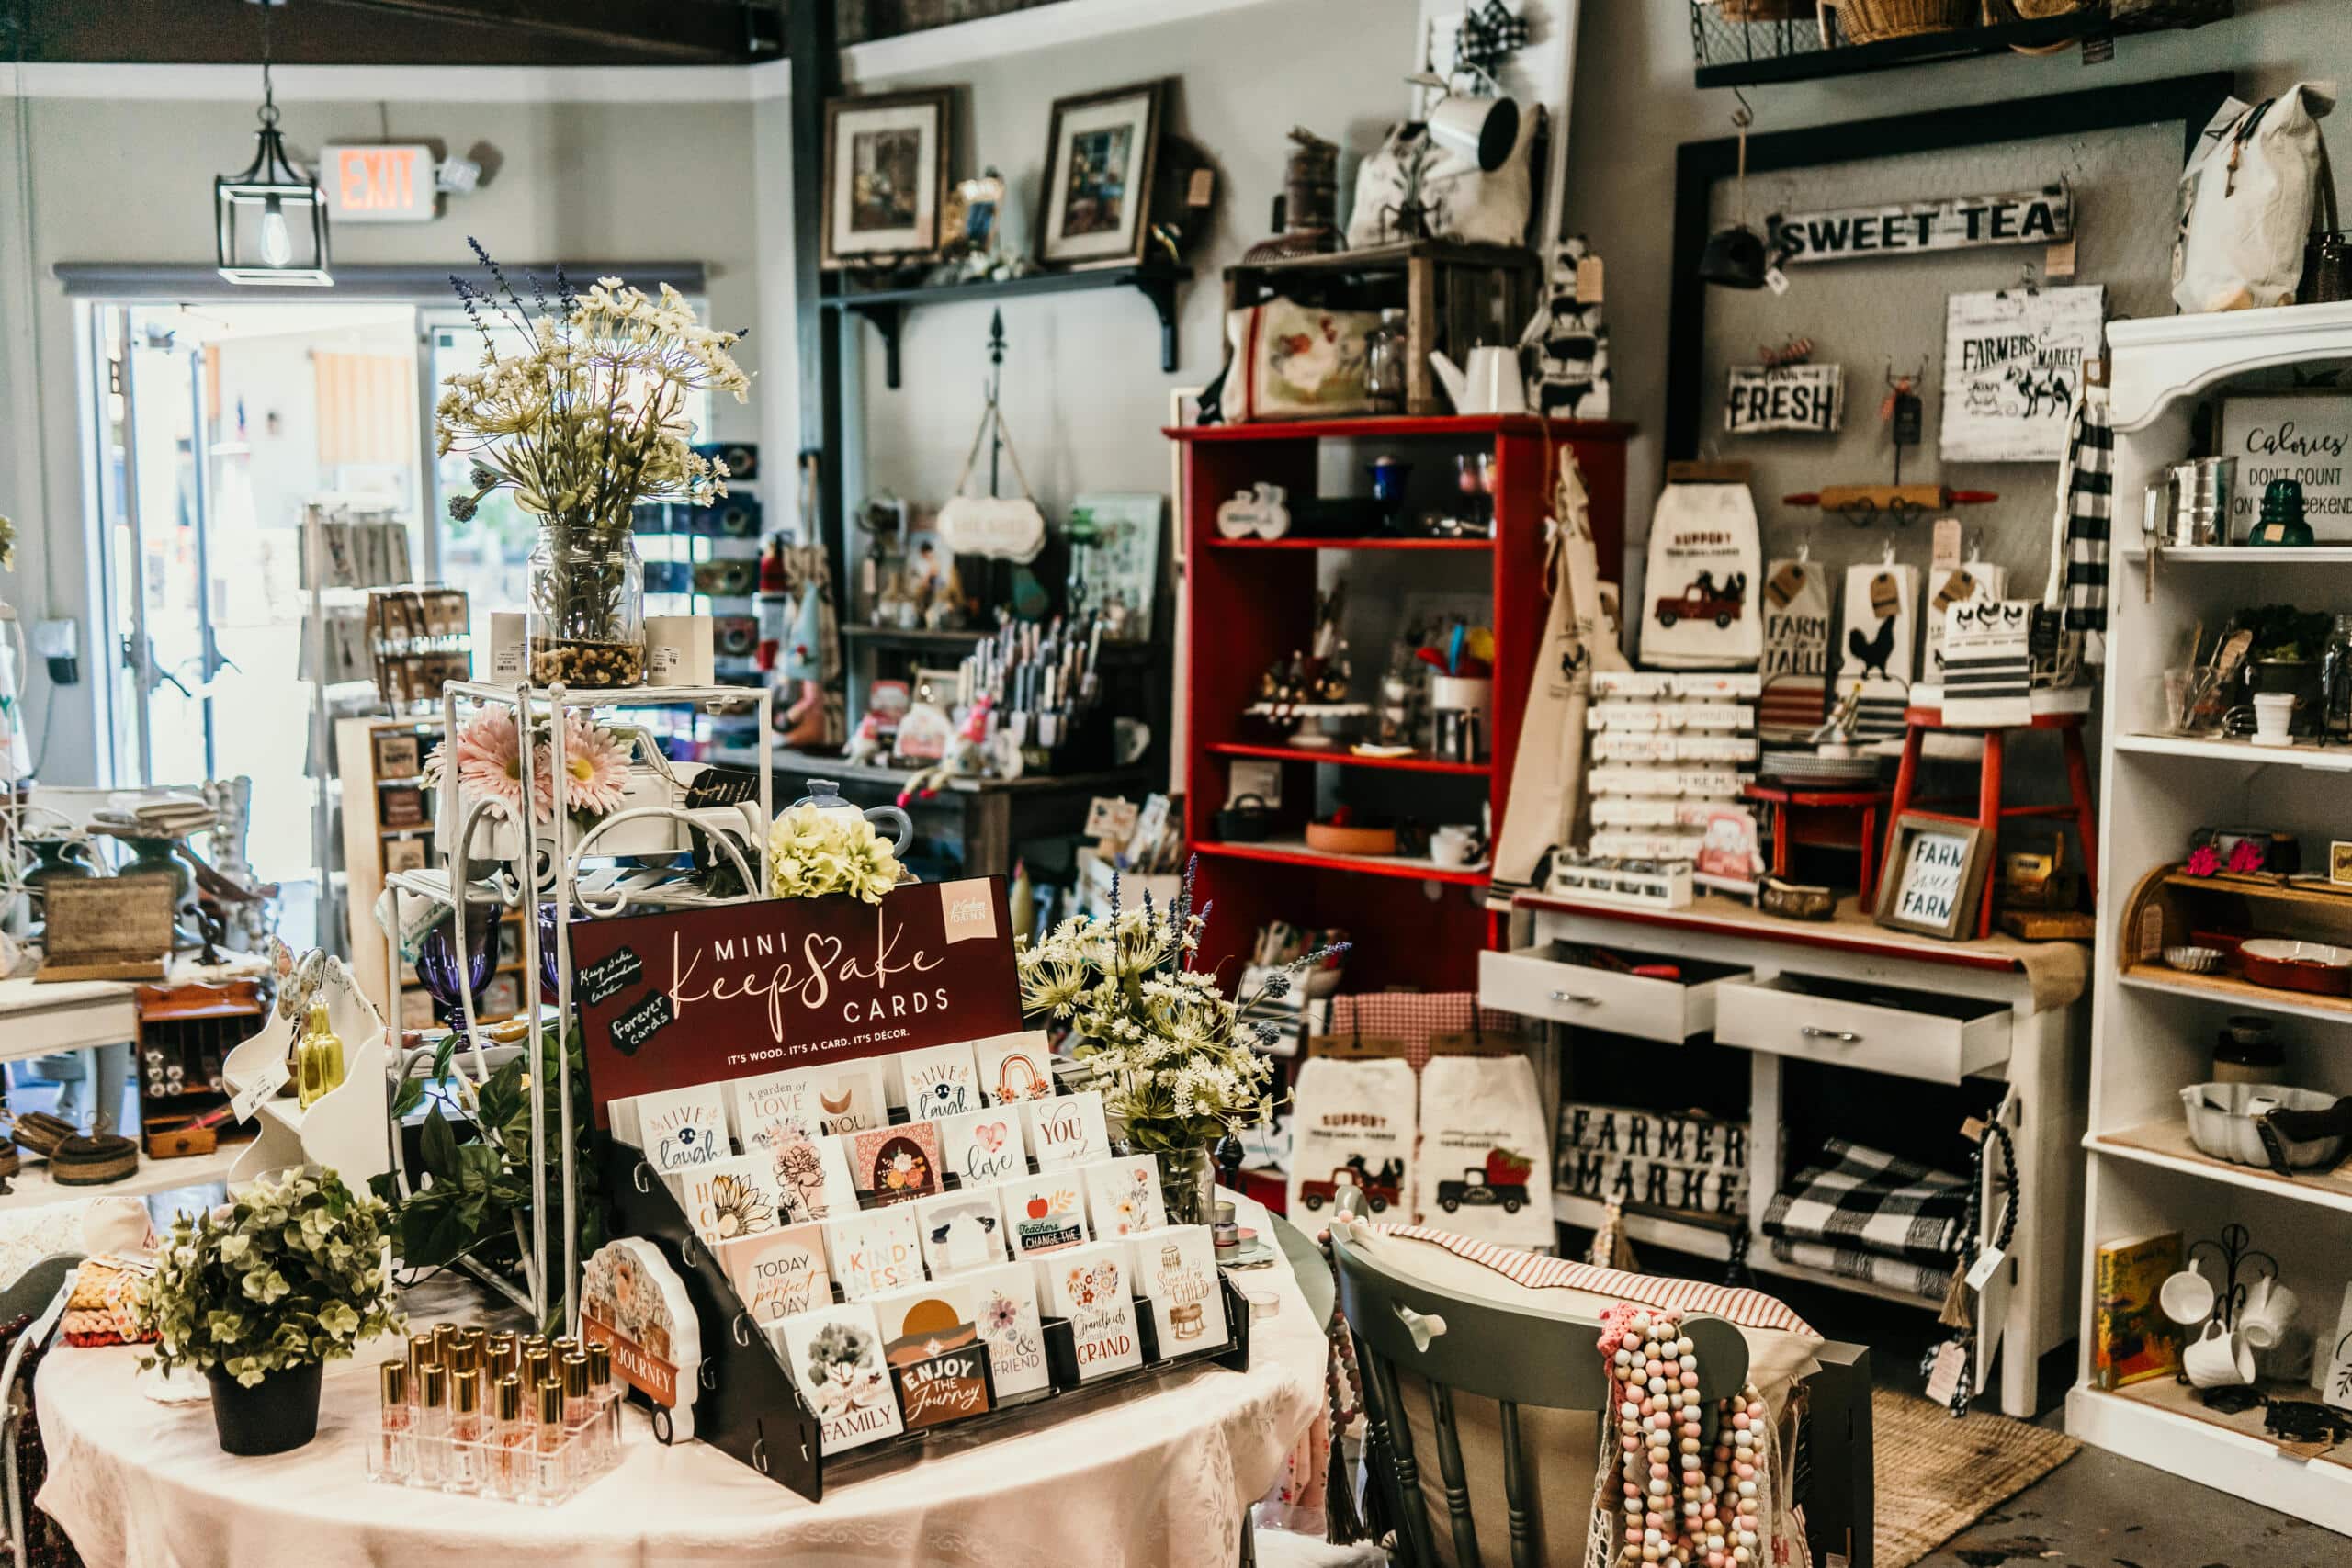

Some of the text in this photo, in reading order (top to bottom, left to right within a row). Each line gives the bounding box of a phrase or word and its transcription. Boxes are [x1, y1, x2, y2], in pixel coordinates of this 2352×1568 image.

[338, 149, 416, 209] EXIT
[1780, 201, 2057, 256] SWEET TEA
[1963, 335, 2036, 371] FARMERS
[2038, 347, 2083, 367] MARKET
[1731, 386, 1833, 428] FRESH
[2246, 421, 2348, 457] Calories
[2250, 467, 2342, 486] DON'T COUNT
[2235, 496, 2252, 515] ON
[1674, 531, 1732, 545] SUPPORT
[1769, 614, 1826, 639] FARM
[715, 932, 787, 962] MINI
[843, 987, 948, 1023] CARDS
[630, 1012, 670, 1044] cards
[728, 1028, 910, 1066] IT'S WOOD. IT'S A CARD. IT'S DÉCOR.
[922, 1064, 956, 1086] LIVE
[747, 1081, 808, 1102] A garden of
[754, 1093, 805, 1118] LOVE
[920, 1086, 973, 1120] laugh
[662, 1106, 704, 1131] LIVE
[829, 1114, 866, 1134] YOU
[1039, 1104, 1083, 1145] YOU
[1322, 1114, 1386, 1128] SUPPORT
[660, 1129, 724, 1169] laugh
[1572, 1109, 1745, 1168] FARMER
[961, 1145, 1013, 1181] love
[1019, 1222, 1059, 1235] Teachers
[1025, 1232, 1059, 1247] CHANGE
[1061, 1228, 1078, 1242] THE
[754, 1254, 809, 1279] TODAY
[771, 1293, 810, 1319] DAY
[1172, 1279, 1209, 1303] CHILD
[994, 1353, 1040, 1376] FRIEND
[1077, 1335, 1130, 1365] GRAND
[617, 1346, 671, 1393] JOURNEY
[902, 1359, 973, 1392] ENJOY
[933, 1376, 958, 1392] THE
[906, 1384, 980, 1421] Journey
[821, 1404, 891, 1443] FAMILY
